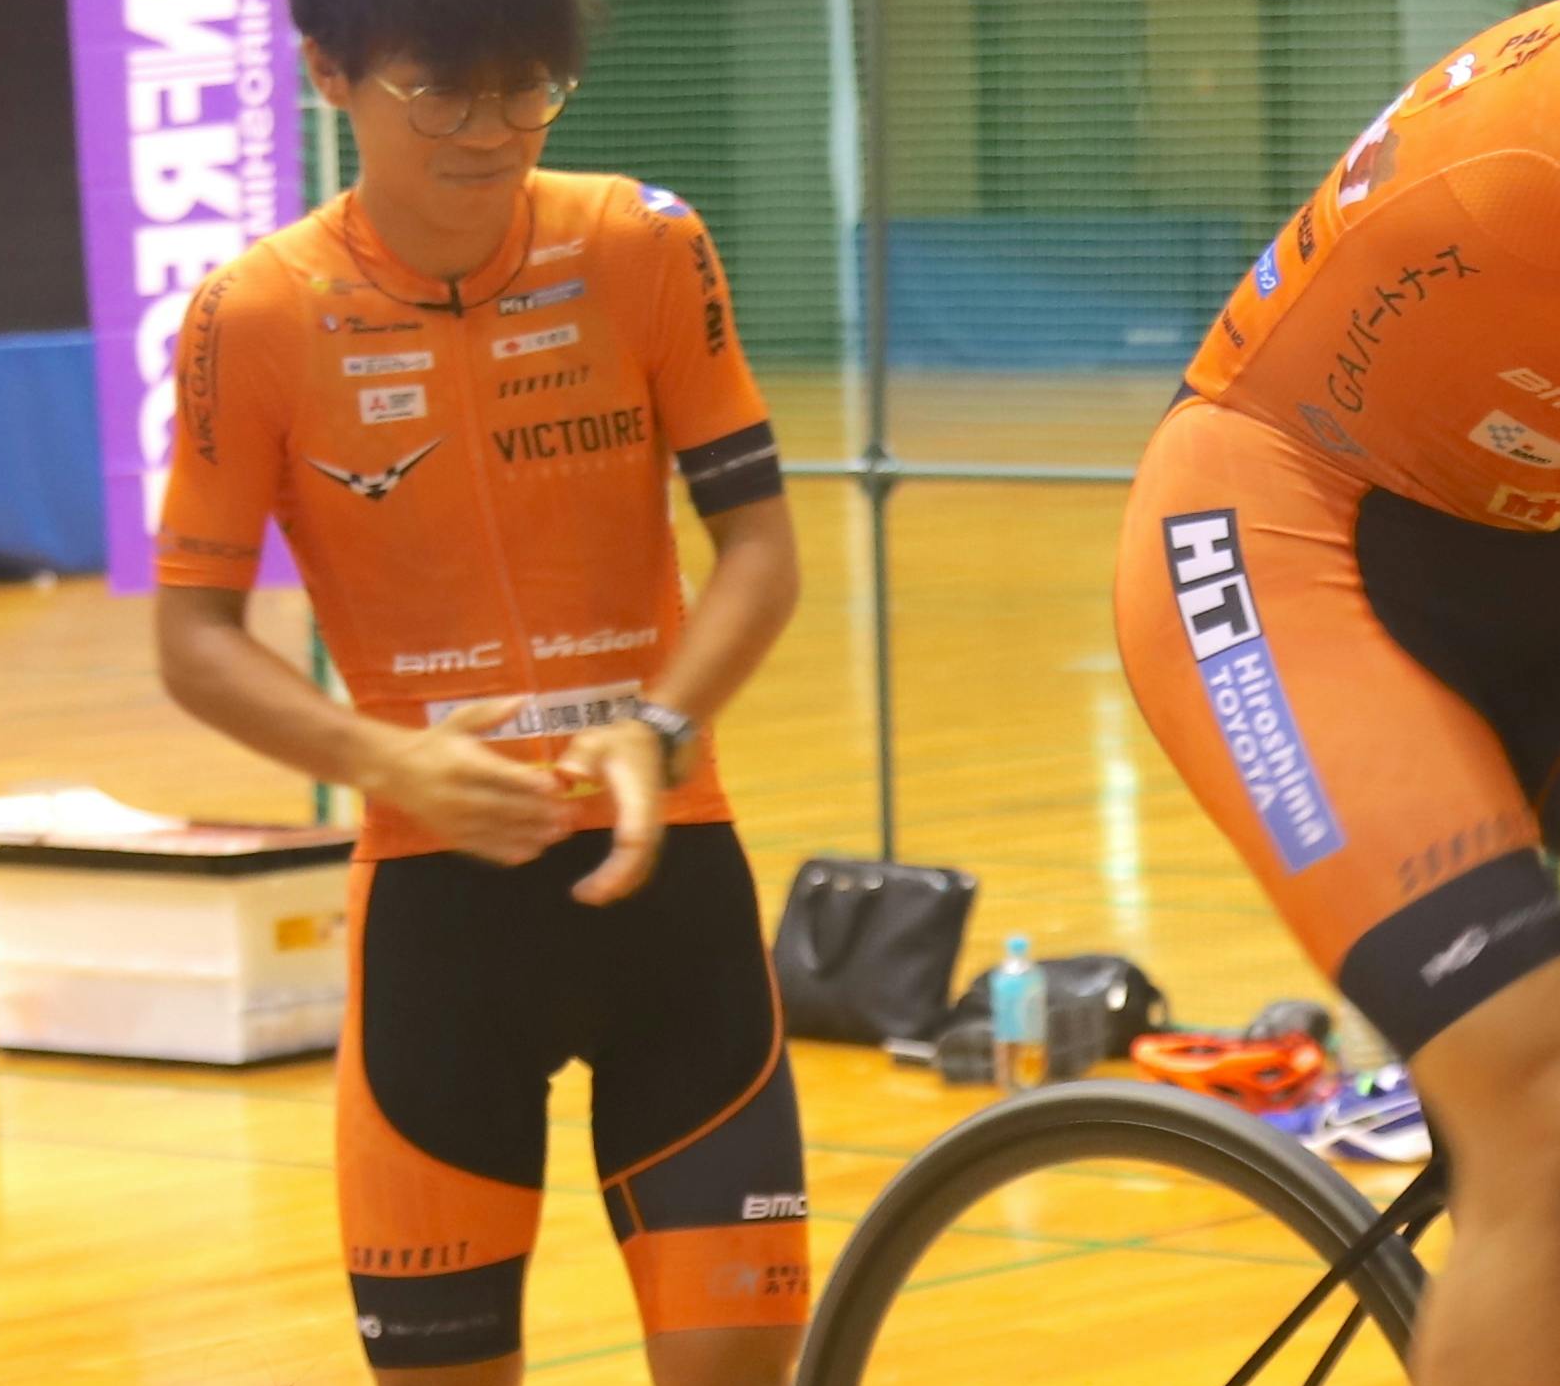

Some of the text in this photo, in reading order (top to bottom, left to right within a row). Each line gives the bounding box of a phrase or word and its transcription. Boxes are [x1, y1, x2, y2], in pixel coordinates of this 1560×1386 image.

[1497, 24, 1554, 57] PAL
[1328, 244, 1482, 413] GAパートナーズ
[493, 407, 648, 464] VICTOIRE
[1208, 664, 1280, 813] TOYOTA
[1233, 650, 1328, 849] Hiroshima
